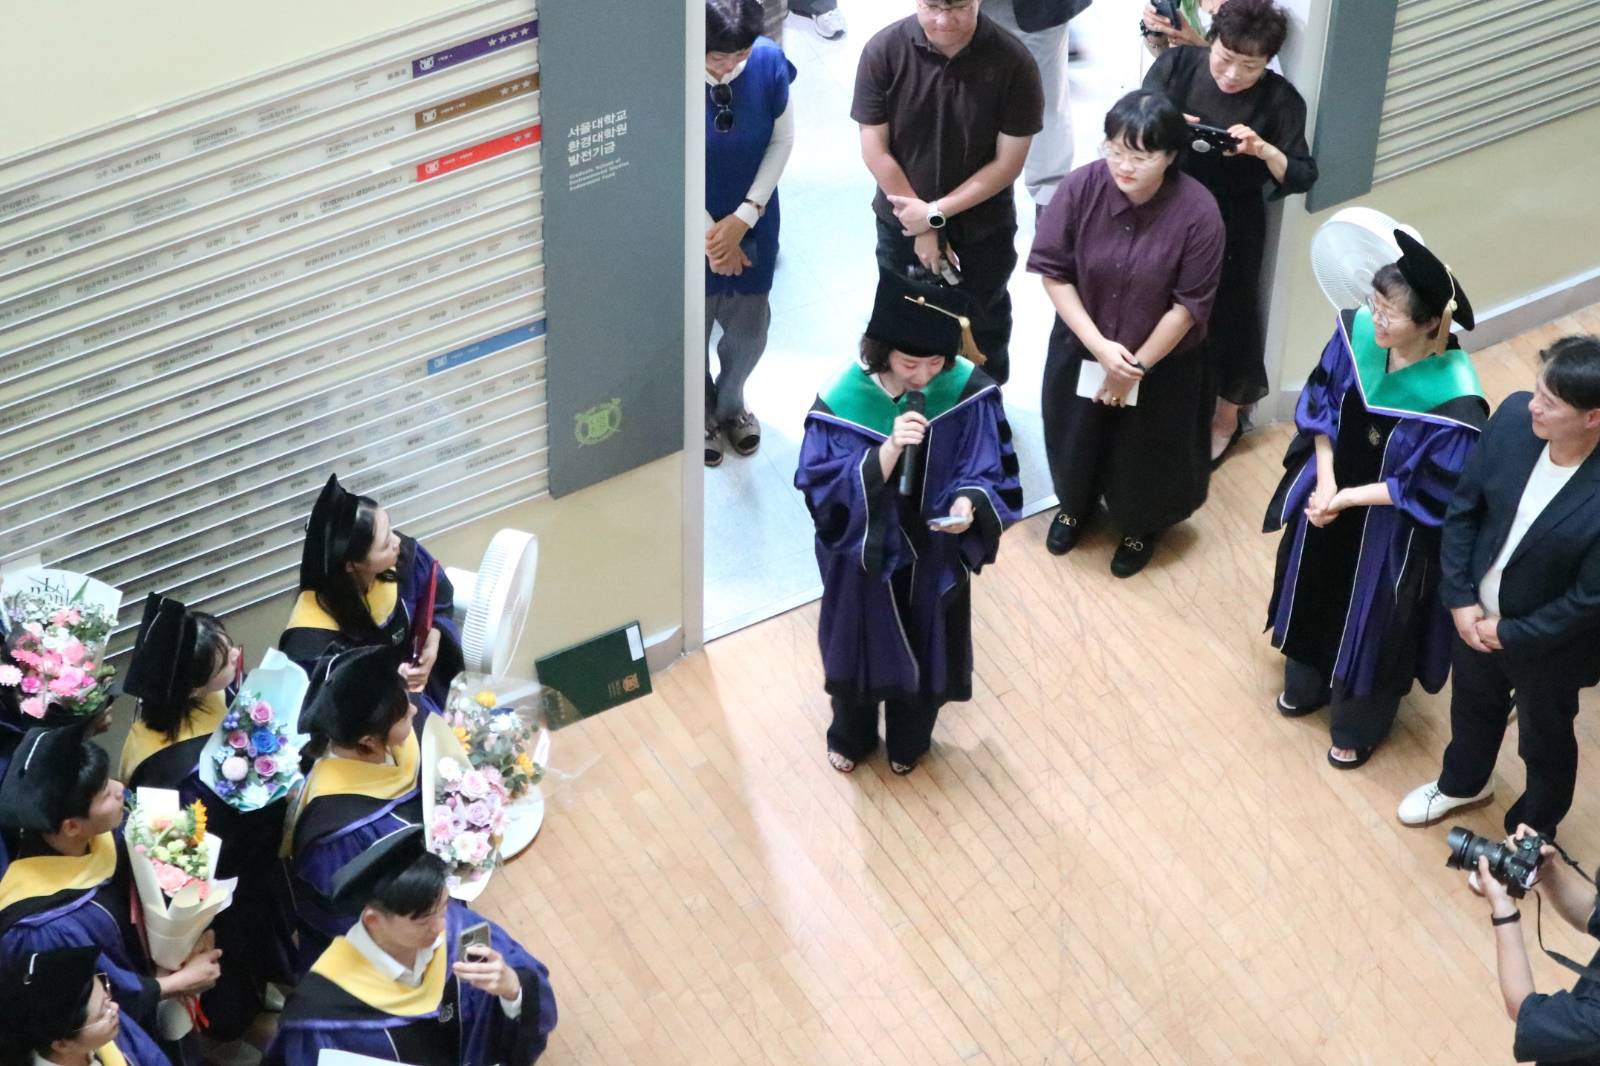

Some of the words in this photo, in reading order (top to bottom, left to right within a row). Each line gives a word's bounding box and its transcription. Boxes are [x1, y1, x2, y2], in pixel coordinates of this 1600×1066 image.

[568, 109, 627, 138] 서울대학교
[568, 122, 627, 153] 환경대학원
[568, 141, 616, 167] 발전기금
